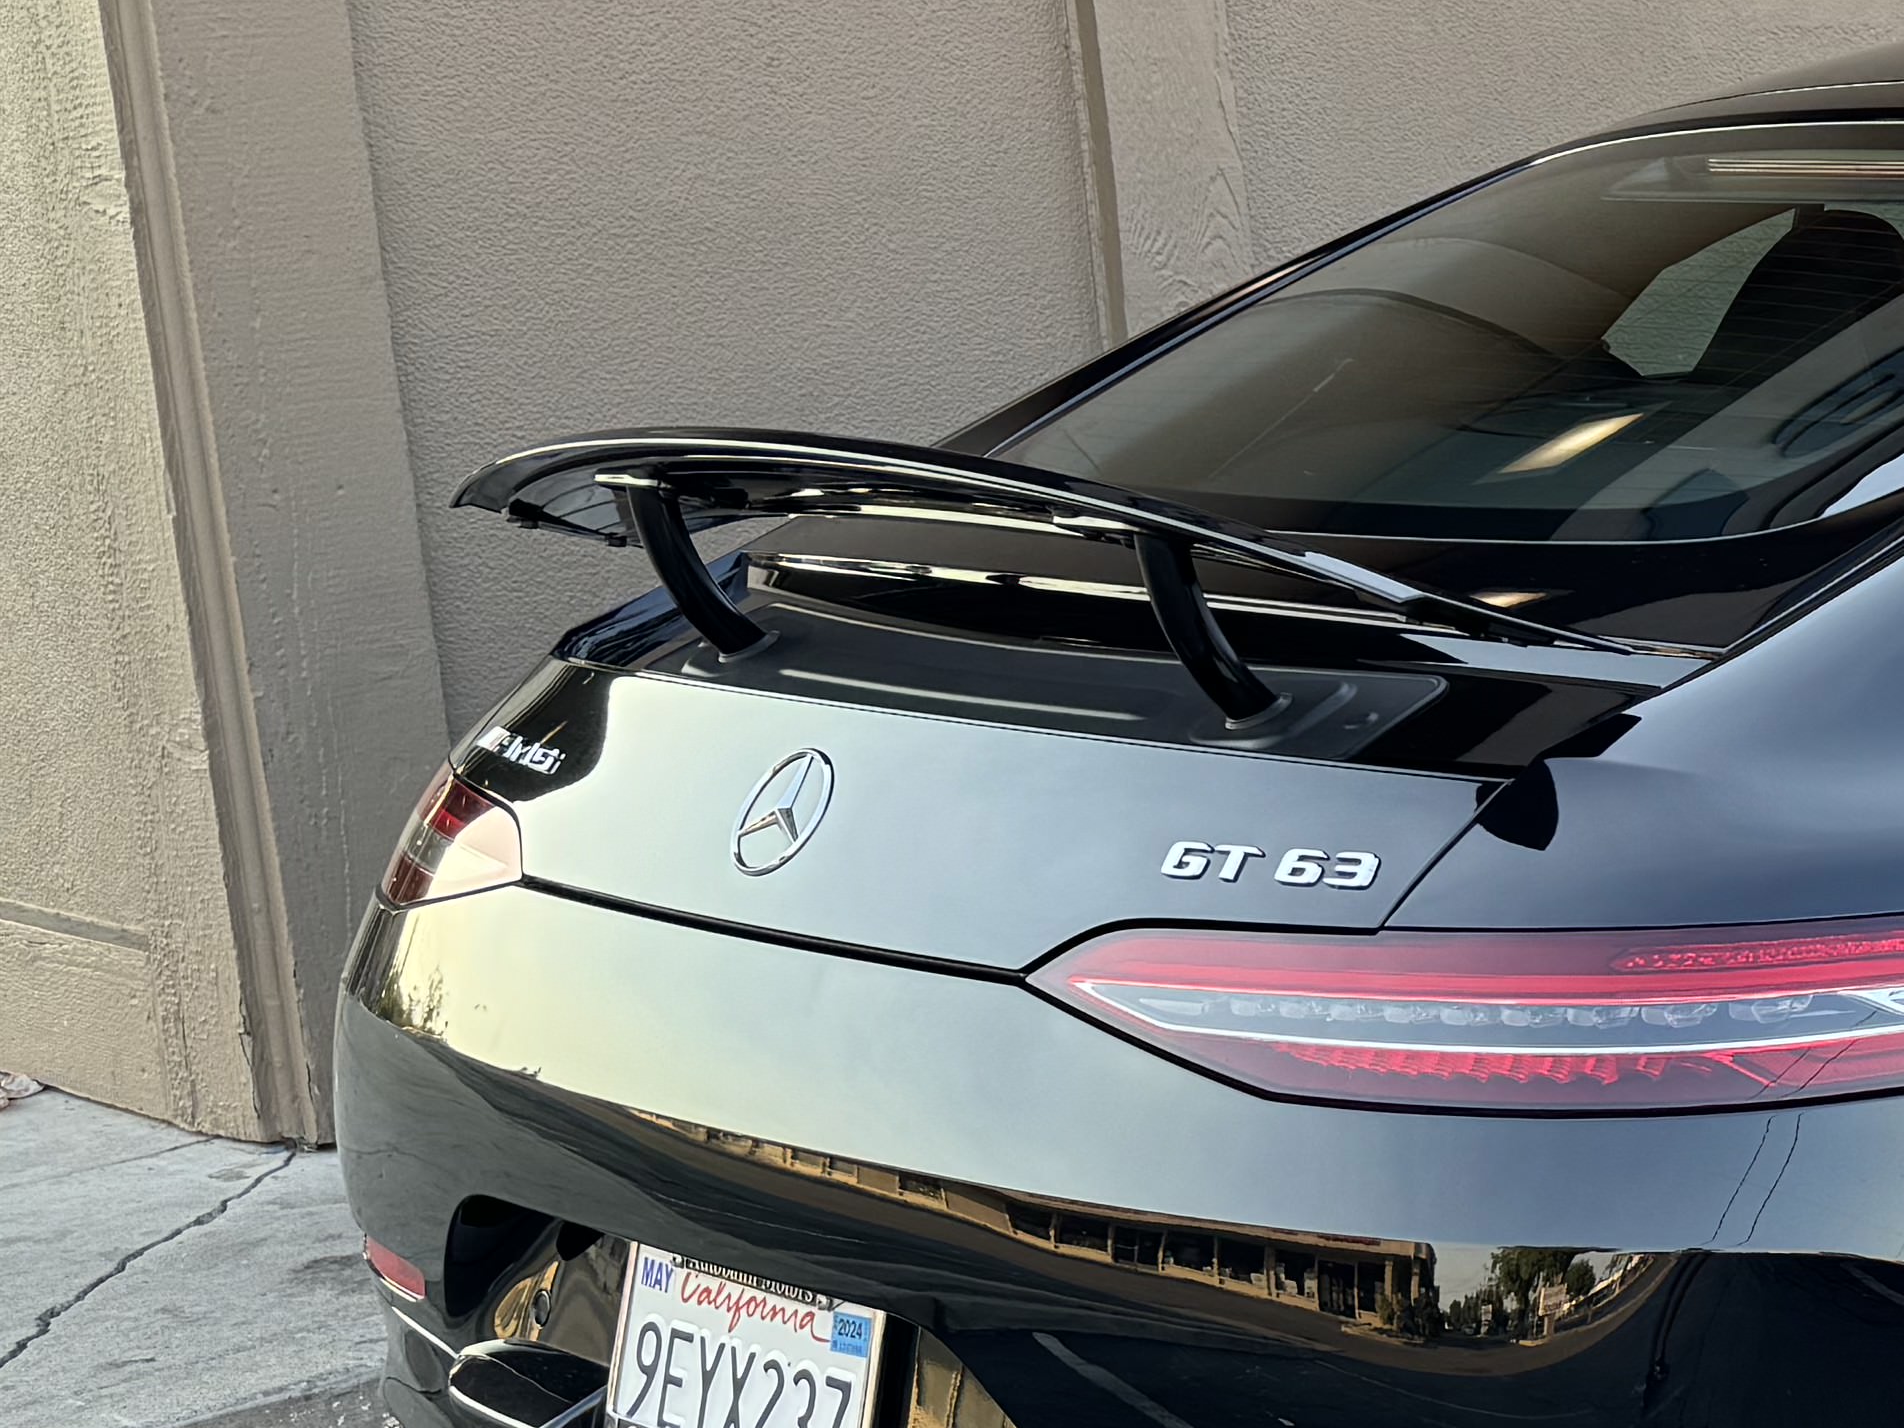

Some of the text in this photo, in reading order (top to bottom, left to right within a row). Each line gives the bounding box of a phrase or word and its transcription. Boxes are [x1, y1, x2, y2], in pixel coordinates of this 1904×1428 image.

[1160, 840, 1382, 890] GT 63
[640, 1256, 863, 1340] MAY 2024
[680, 1271, 831, 1344] California
